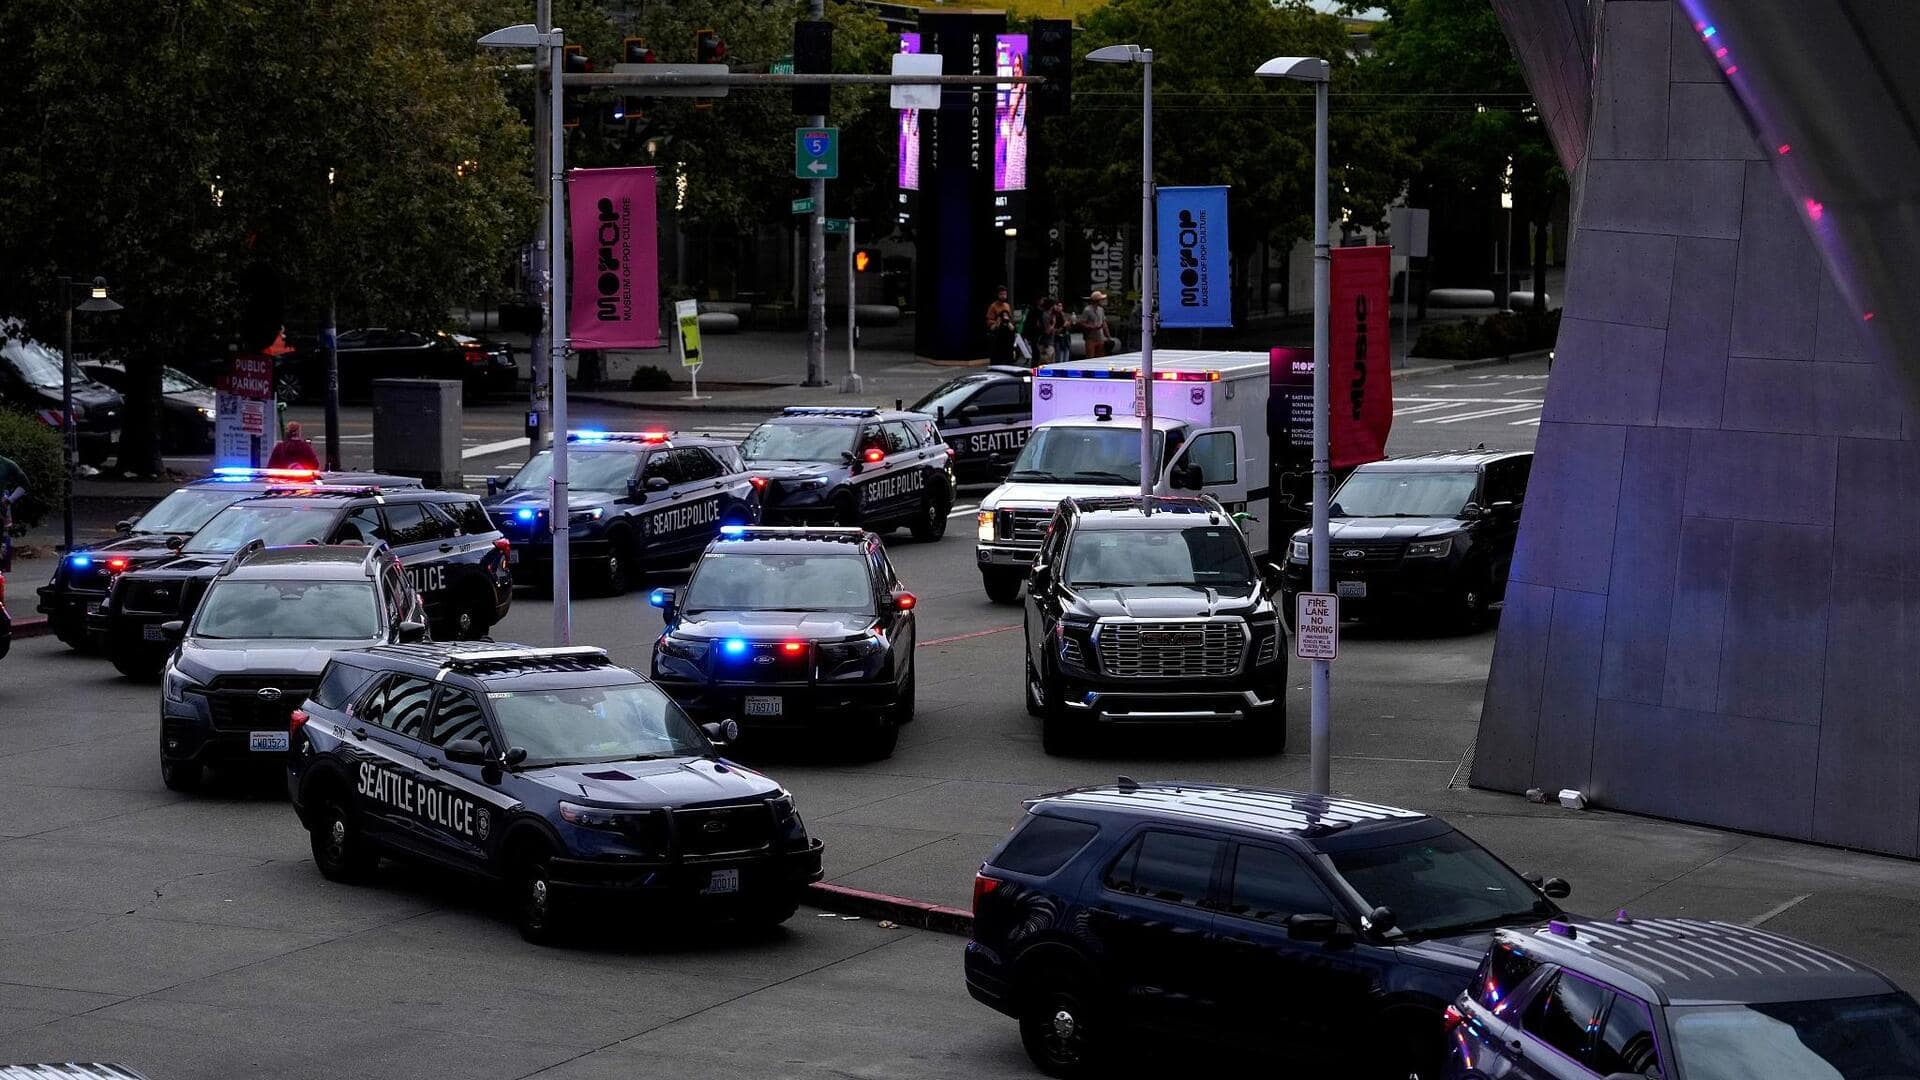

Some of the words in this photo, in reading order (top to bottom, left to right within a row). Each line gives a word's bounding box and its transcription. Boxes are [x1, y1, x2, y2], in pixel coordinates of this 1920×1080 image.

[812, 139, 822, 152] 5
[622, 197, 631, 240] CULTURE
[1199, 209, 1207, 244] CULTURE
[623, 242, 631, 262] POP
[1200, 244, 1208, 261] POP
[623, 263, 632, 277] OF
[1090, 241, 1109, 291] AGELS
[1201, 262, 1208, 273] OF
[623, 278, 632, 321] MUSEUM
[235, 359, 267, 374] PUBLIC
[1350, 294, 1367, 421] MUSIC
[232, 376, 269, 395] PARKING
[970, 430, 1025, 453] SEATTLE
[868, 477, 897, 502] SEATTLE
[896, 470, 925, 497] POLICE
[653, 507, 687, 535] SEATTLE
[686, 499, 721, 527] POLICE
[407, 565, 447, 593] OLICE
[1306, 608, 1329, 616] LANE
[1308, 599, 1327, 607] FIRE
[1301, 625, 1333, 633] PARKING
[357, 761, 414, 812] SEATTLE
[417, 783, 474, 836] POLICE
